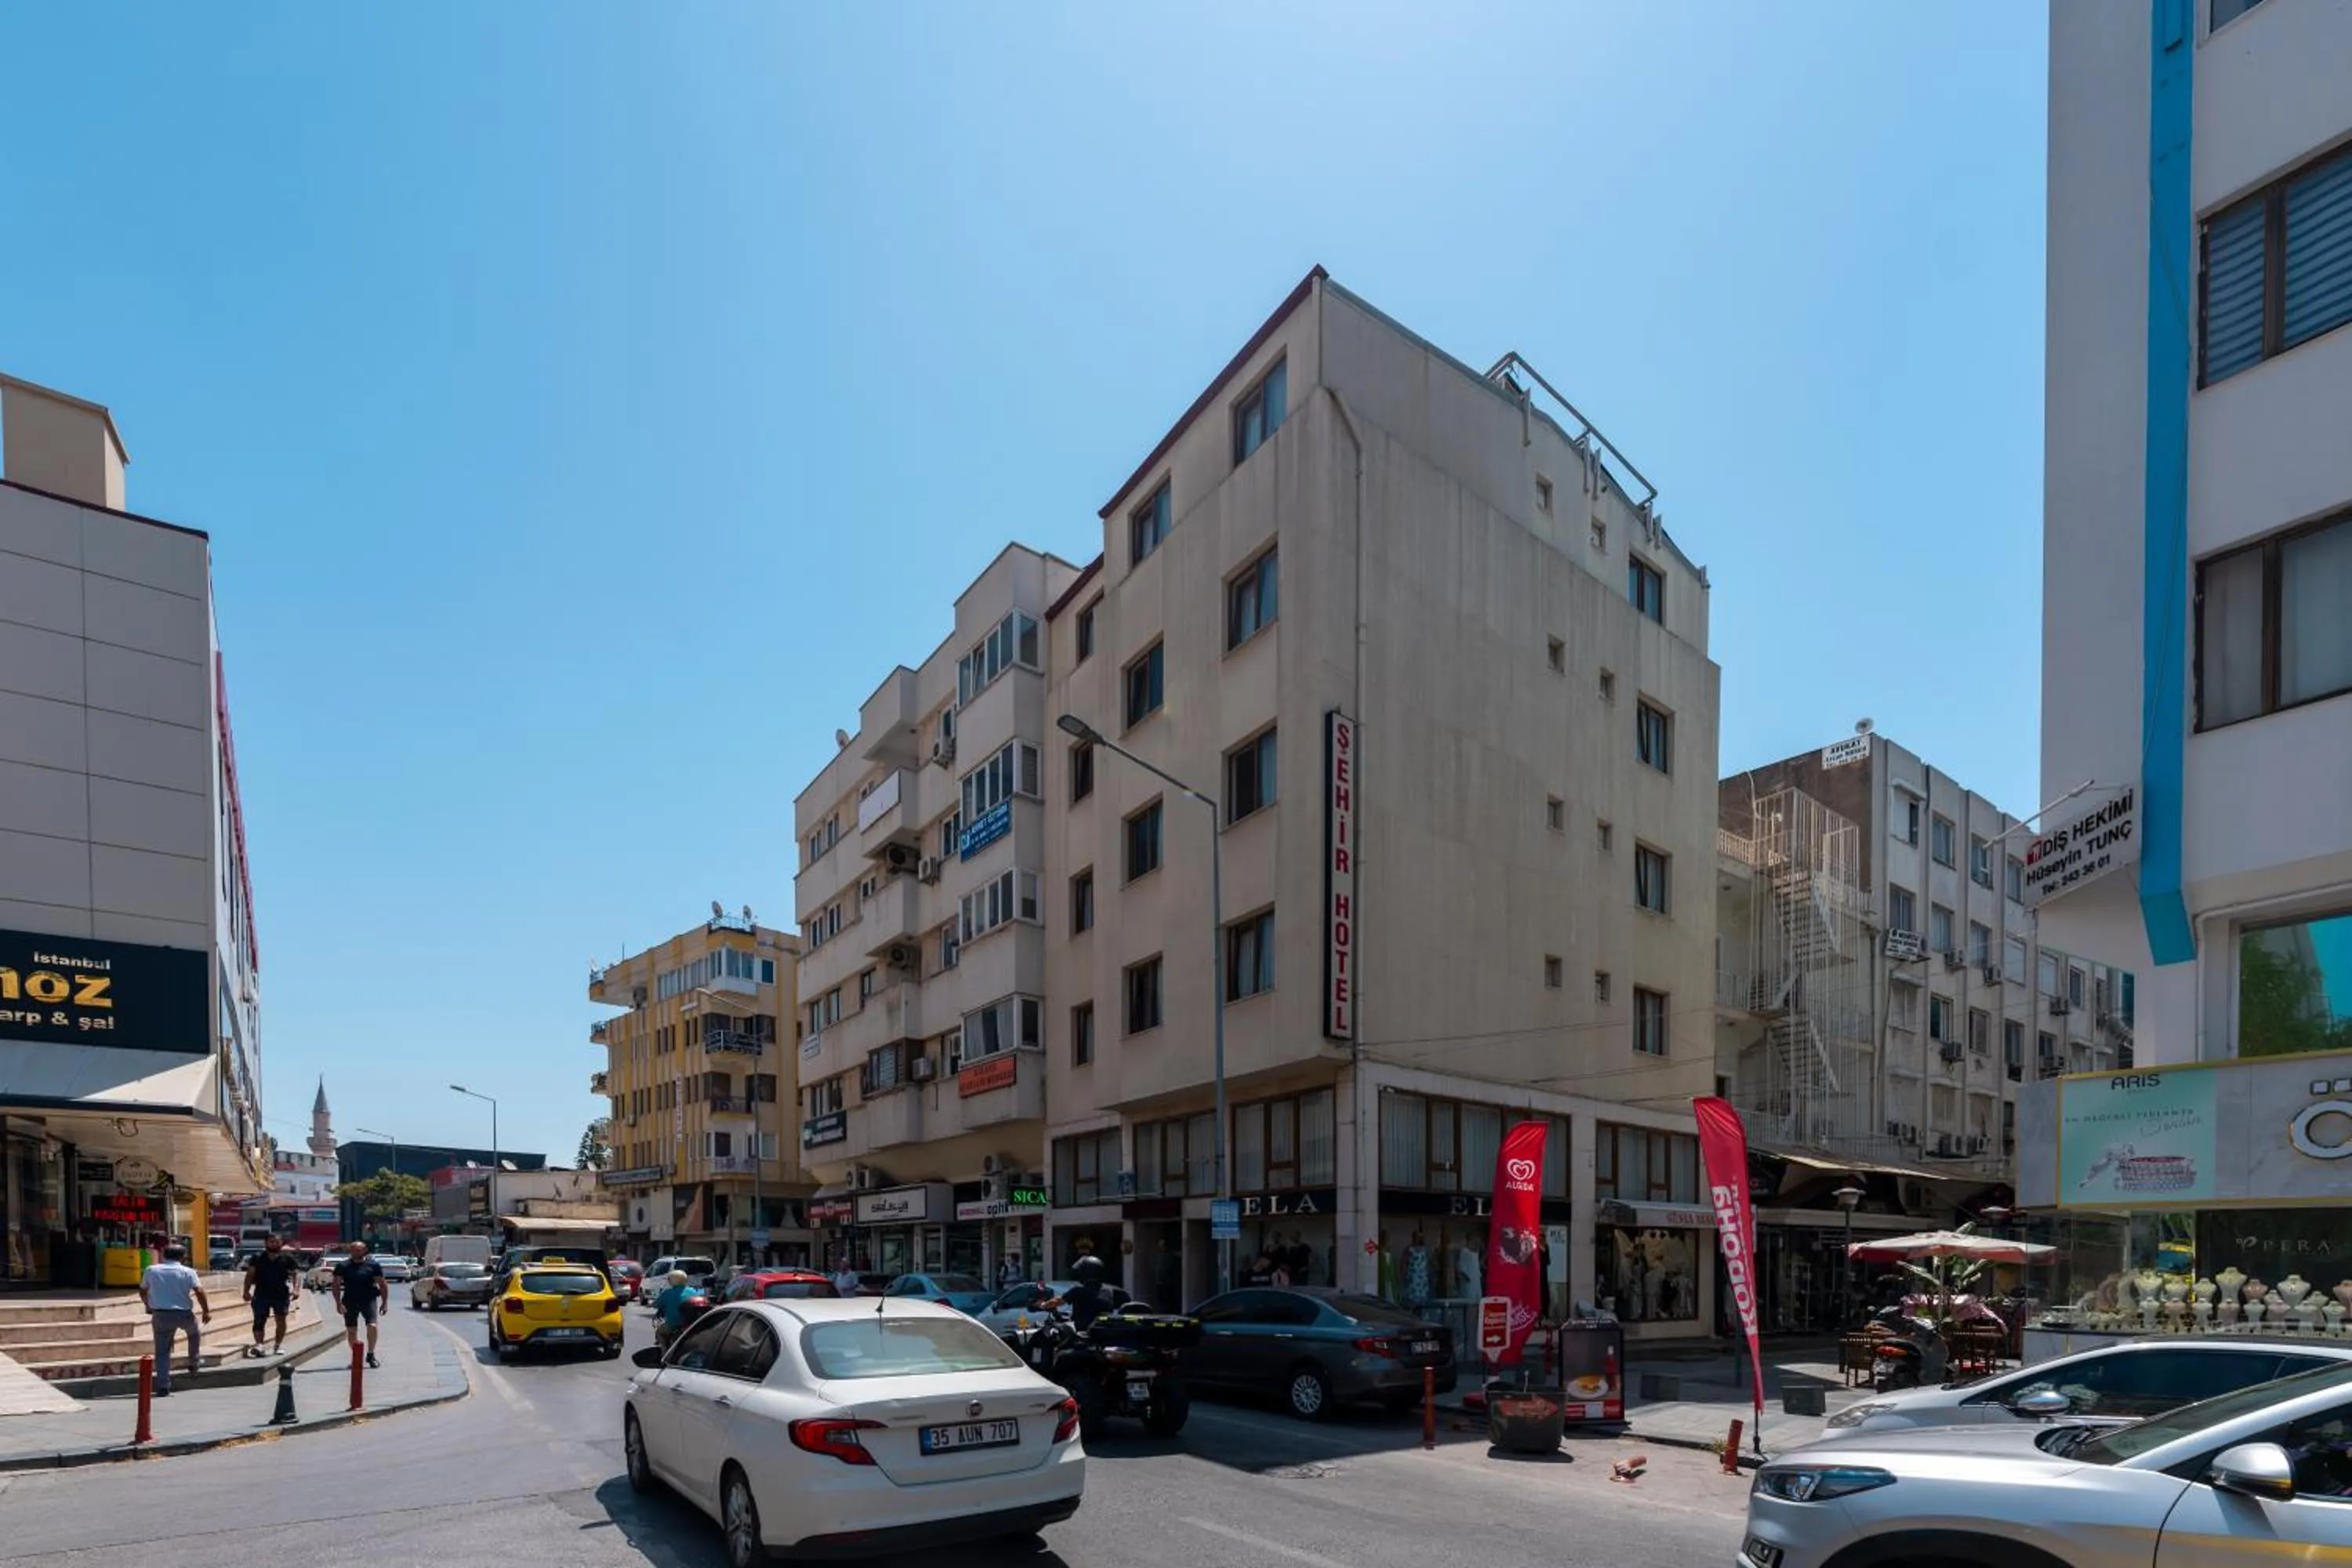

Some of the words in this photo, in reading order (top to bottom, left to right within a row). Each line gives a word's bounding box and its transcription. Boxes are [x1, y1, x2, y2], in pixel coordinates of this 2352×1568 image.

[2042, 829, 2068, 858] DİŞ
[2072, 787, 2134, 841] HEKİMİ
[2026, 849, 2082, 887] Hüseyin
[2085, 819, 2133, 855] TUNÇ
[1335, 893, 1349, 1031] HOTEL
[0, 1010, 42, 1027] arp
[51, 1011, 70, 1026] &
[1505, 1181, 1534, 1192] ALGIDA
[1243, 1192, 1319, 1216] ELA
[1451, 1196, 1492, 1217] EL
[931, 1428, 949, 1449] 35
[958, 1425, 983, 1445] AUN
[990, 1421, 1014, 1441] 707
